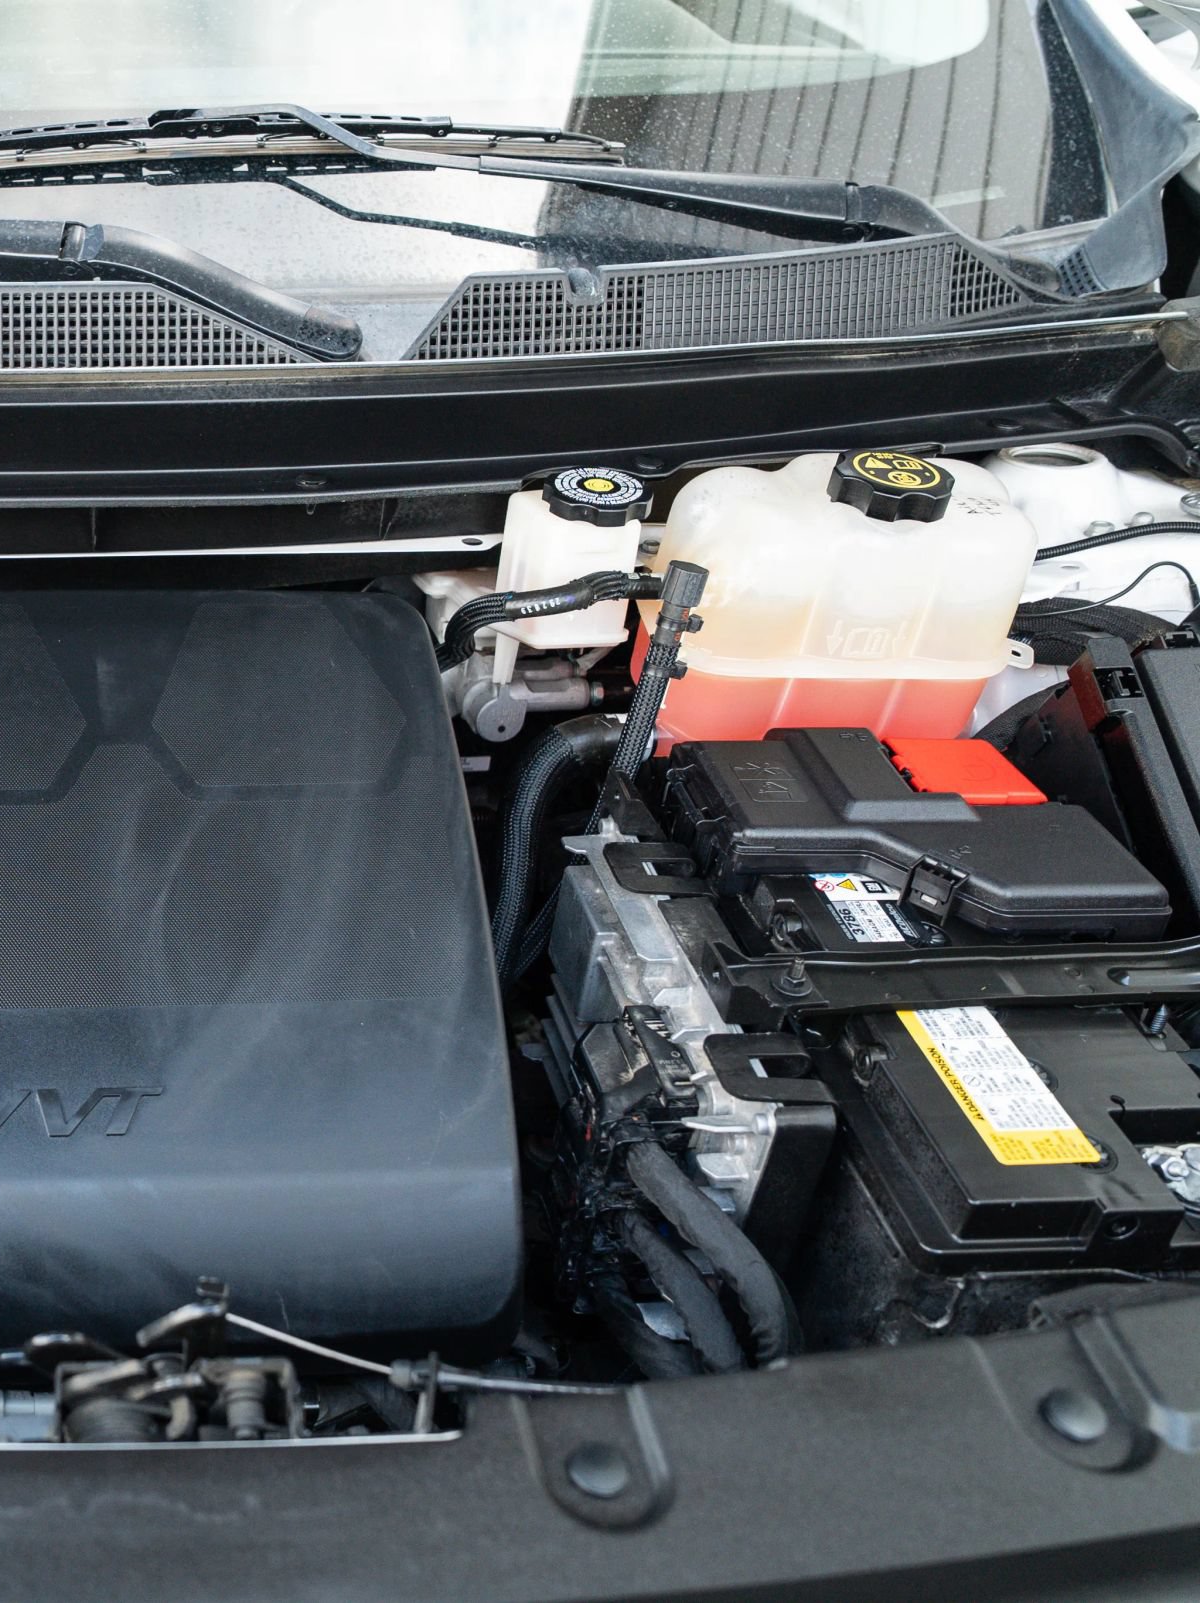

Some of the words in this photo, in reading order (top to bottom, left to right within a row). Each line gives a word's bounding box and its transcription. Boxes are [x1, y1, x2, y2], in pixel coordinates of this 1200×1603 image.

[839, 908, 865, 936] 3786
[927, 1047, 953, 1077] POISON
[949, 1079, 978, 1112] DANGER
